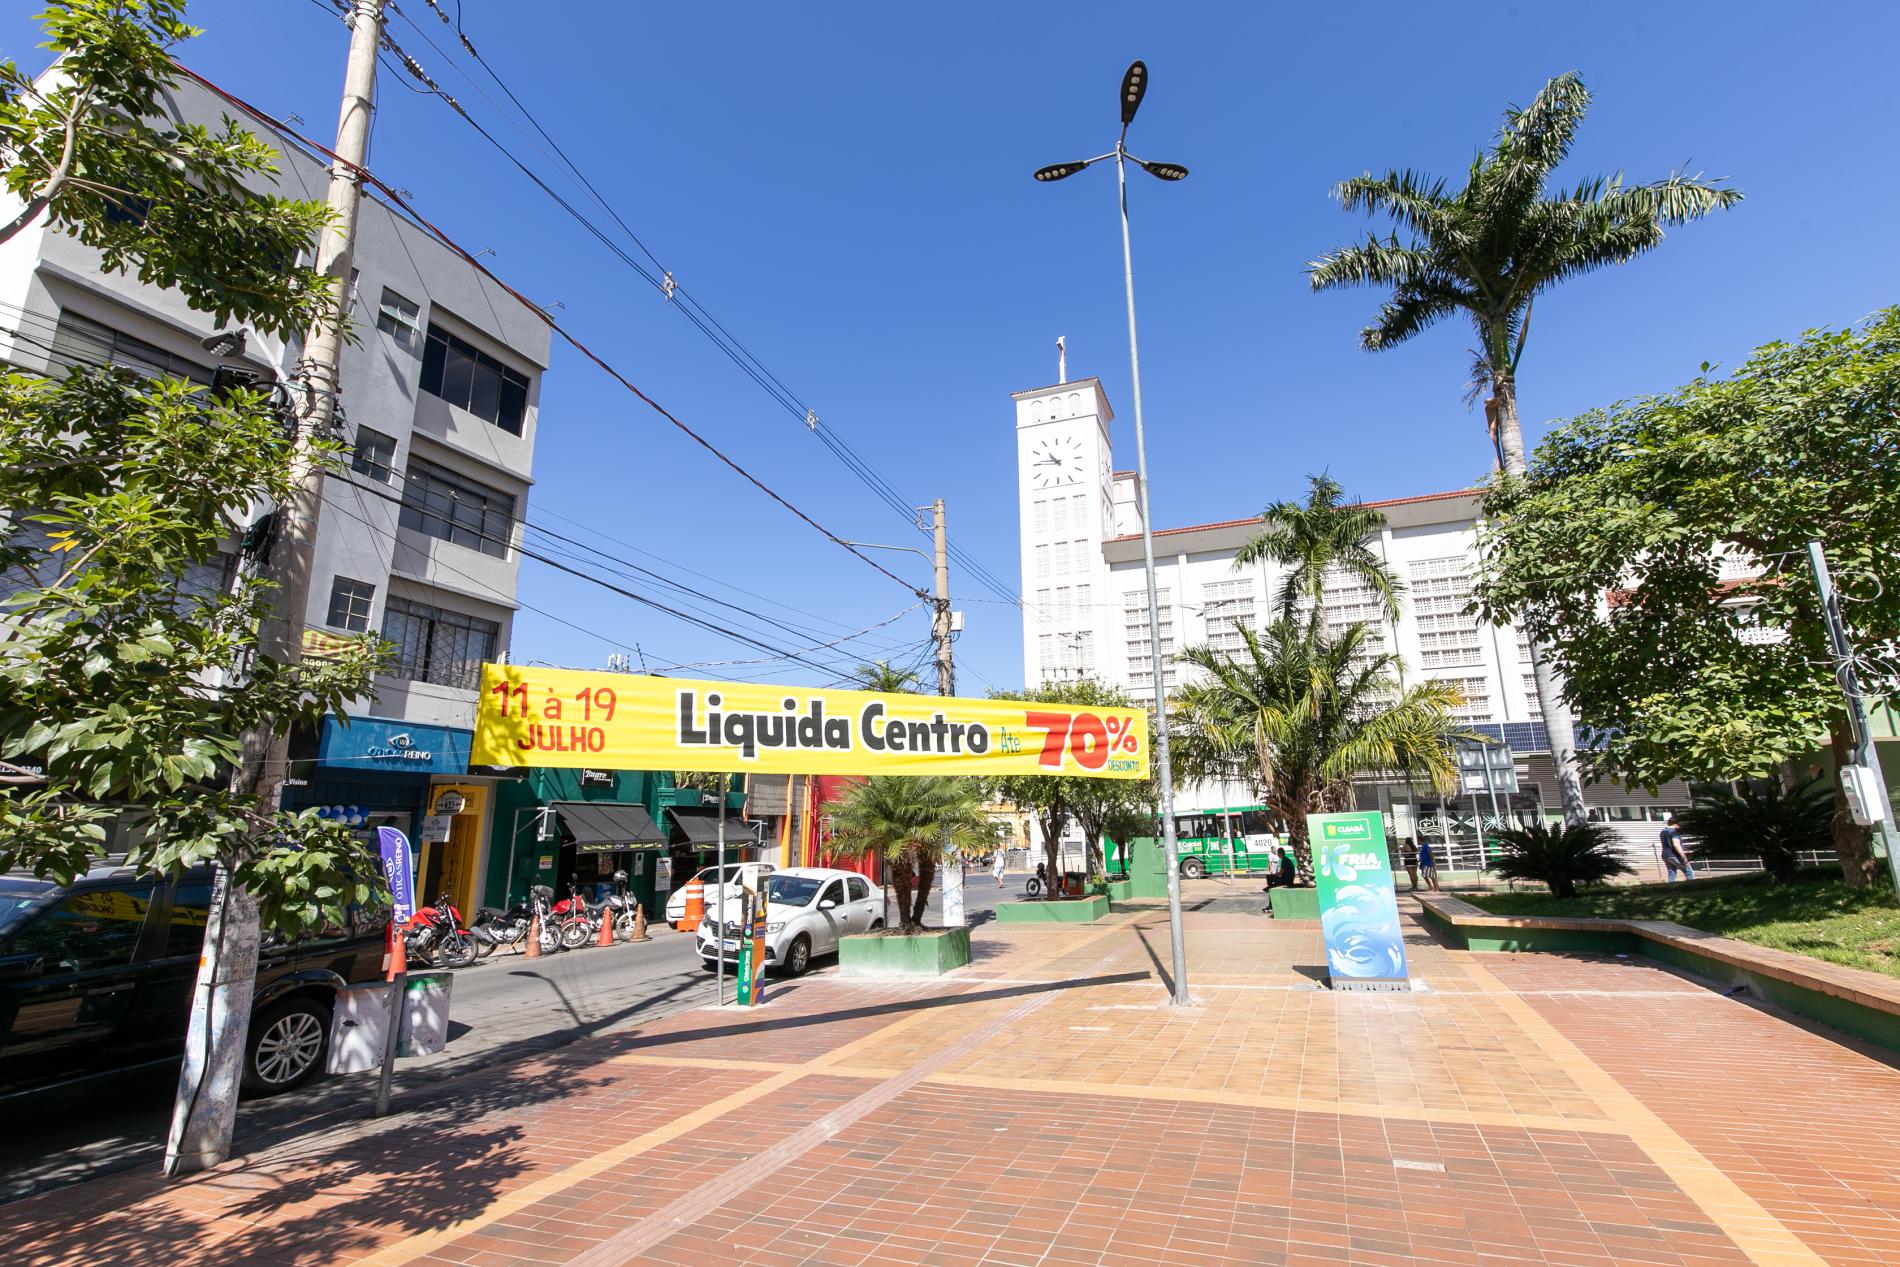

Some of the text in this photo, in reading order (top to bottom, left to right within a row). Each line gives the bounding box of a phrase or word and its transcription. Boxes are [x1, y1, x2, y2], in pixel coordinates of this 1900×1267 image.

[492, 681, 617, 721] 11 à 19
[517, 724, 605, 752] JULHO
[680, 692, 989, 757] Liquida Centro
[1026, 711, 1138, 769] 70%
[1107, 759, 1140, 772] DESCONTO
[1254, 838, 1273, 847] 4020
[1336, 824, 1365, 833] CUIABÁ
